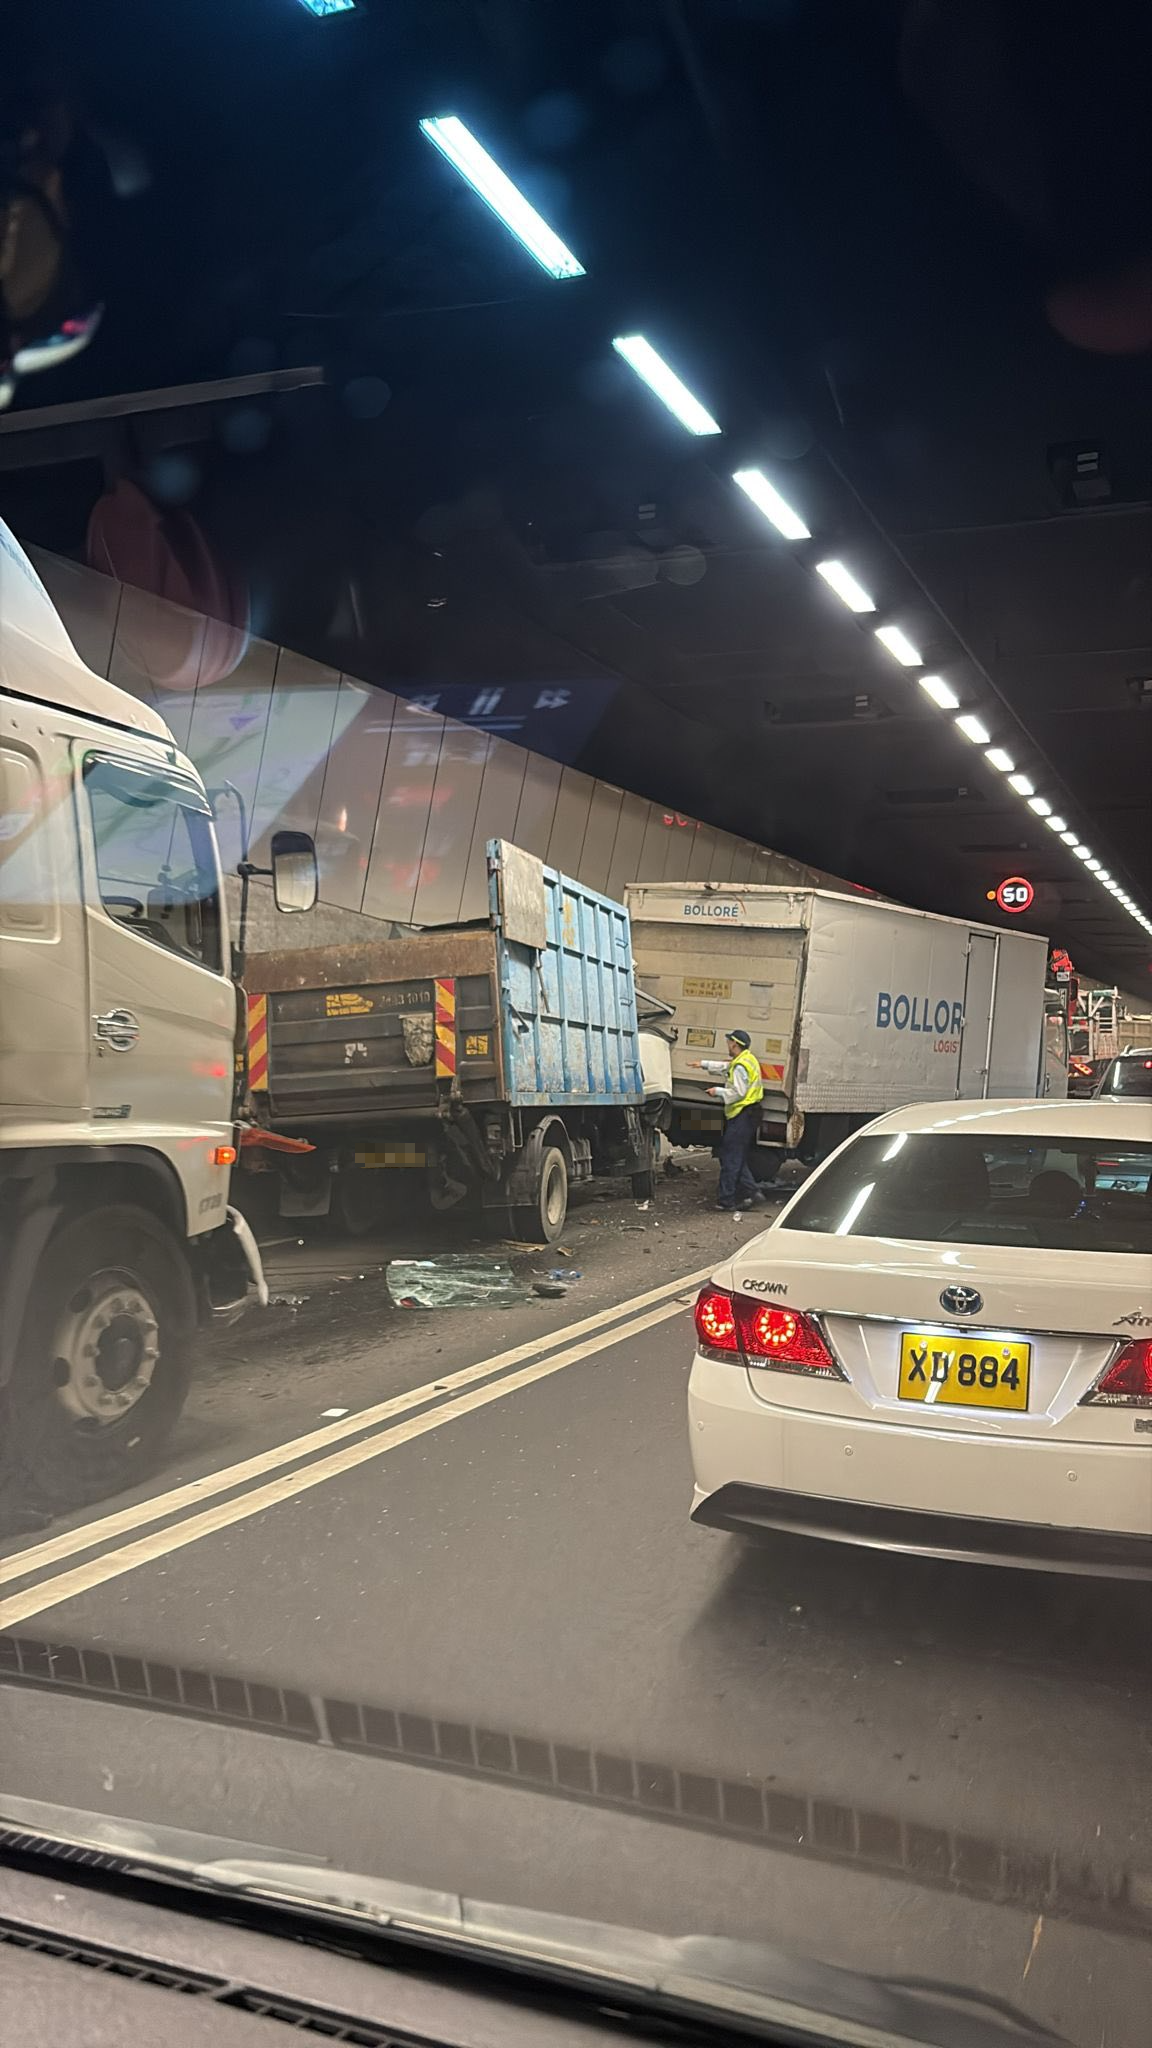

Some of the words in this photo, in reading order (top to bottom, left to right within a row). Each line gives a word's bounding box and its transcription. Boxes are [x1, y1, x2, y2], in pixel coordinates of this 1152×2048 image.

[1003, 887, 1028, 903] 50
[684, 903, 739, 918] BOLLORÉ
[933, 1040, 960, 1054] LOGIS
[742, 1278, 789, 1296] CROWN
[957, 1353, 1020, 1391] 884
